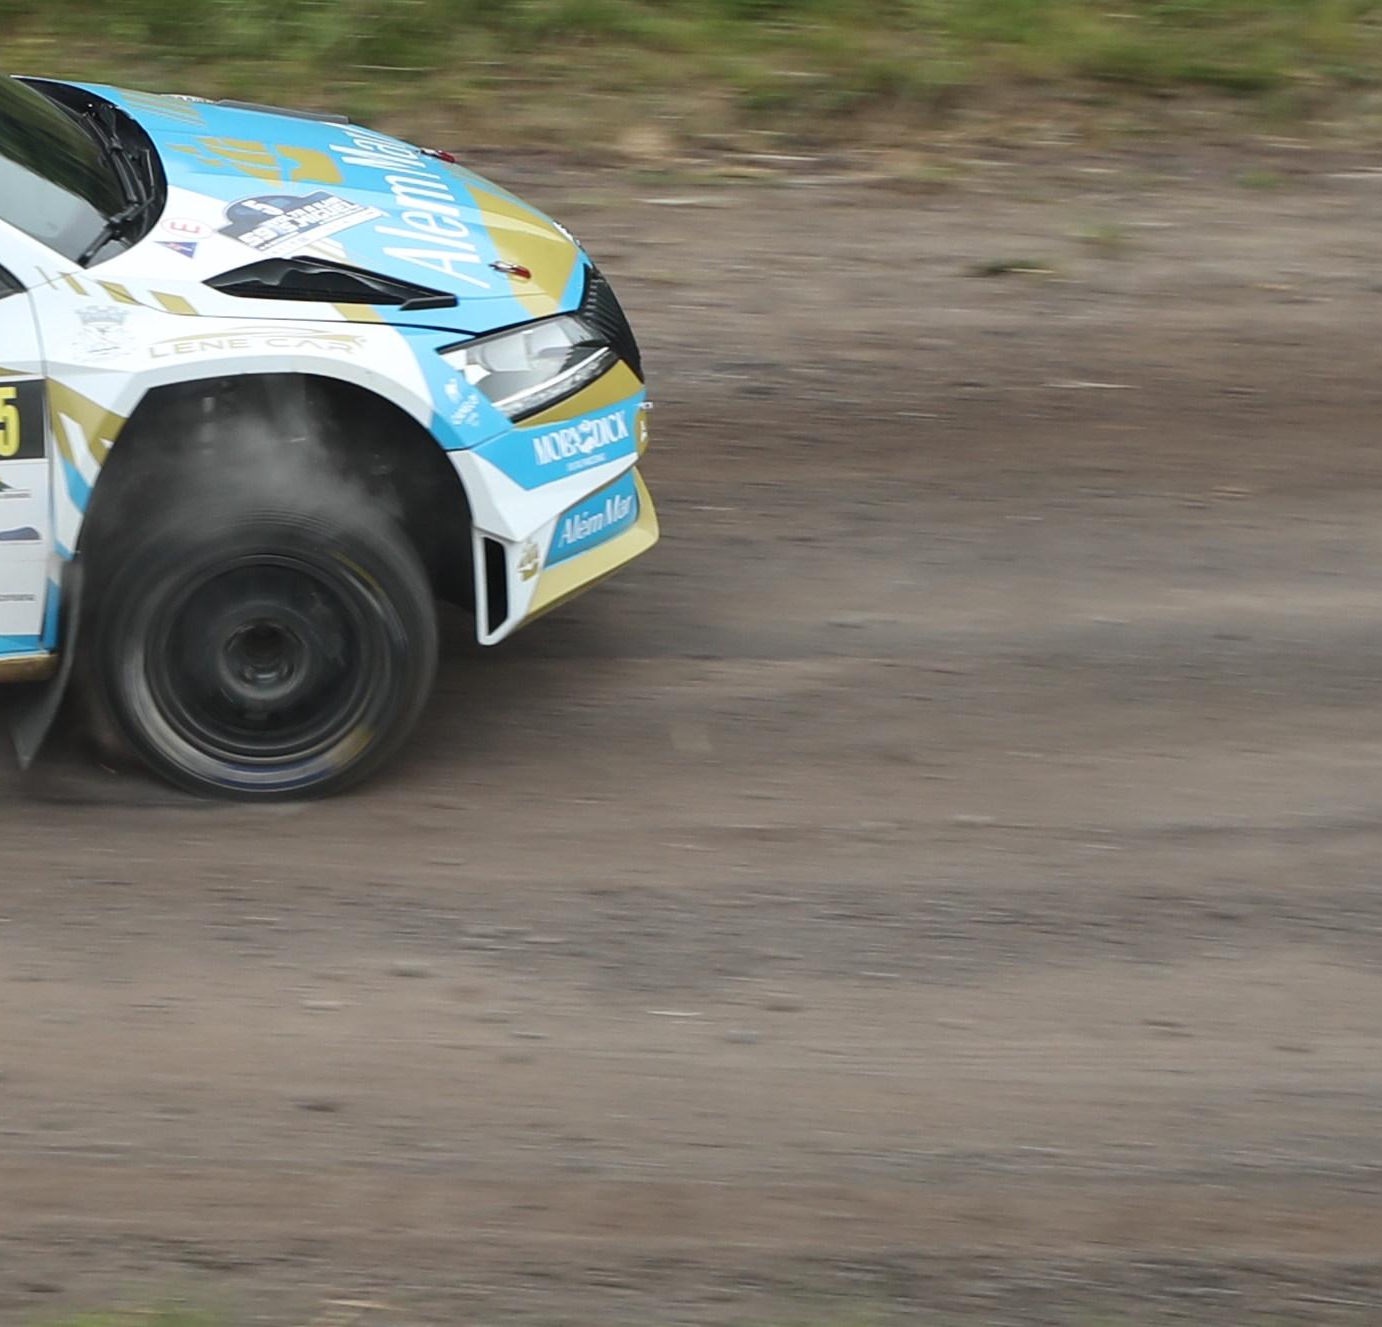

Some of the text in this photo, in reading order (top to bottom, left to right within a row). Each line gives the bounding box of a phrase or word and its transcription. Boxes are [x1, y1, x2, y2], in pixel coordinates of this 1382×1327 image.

[374, 175, 491, 289] Além
[148, 337, 250, 359] LENE
[593, 410, 630, 448] DICK
[559, 494, 634, 547] Além Mar
